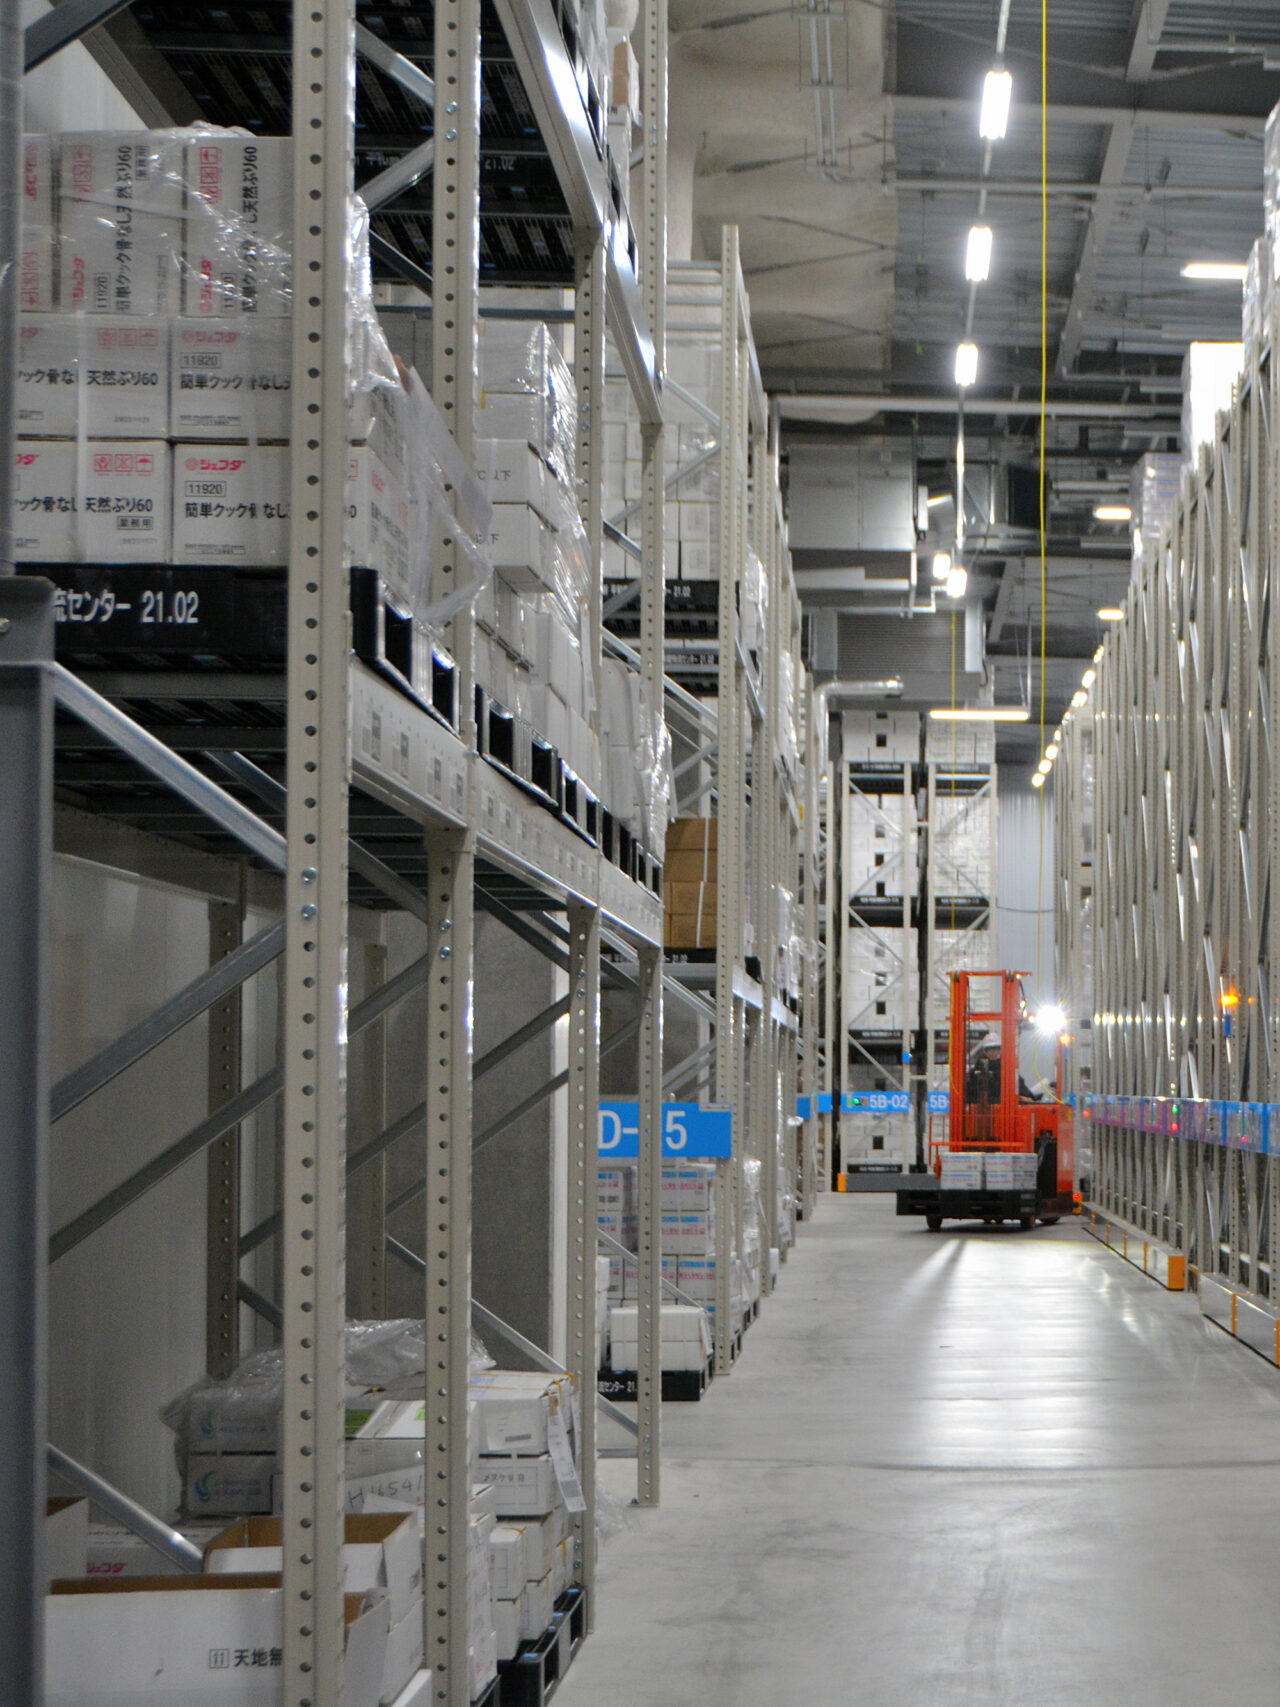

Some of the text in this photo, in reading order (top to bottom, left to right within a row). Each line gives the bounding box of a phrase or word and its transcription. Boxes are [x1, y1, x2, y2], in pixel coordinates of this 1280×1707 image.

[184, 355, 218, 366] 11920
[188, 483, 223, 494] 11920
[141, 591, 199, 623] 21.02
[869, 1094, 908, 1109] 5B-02
